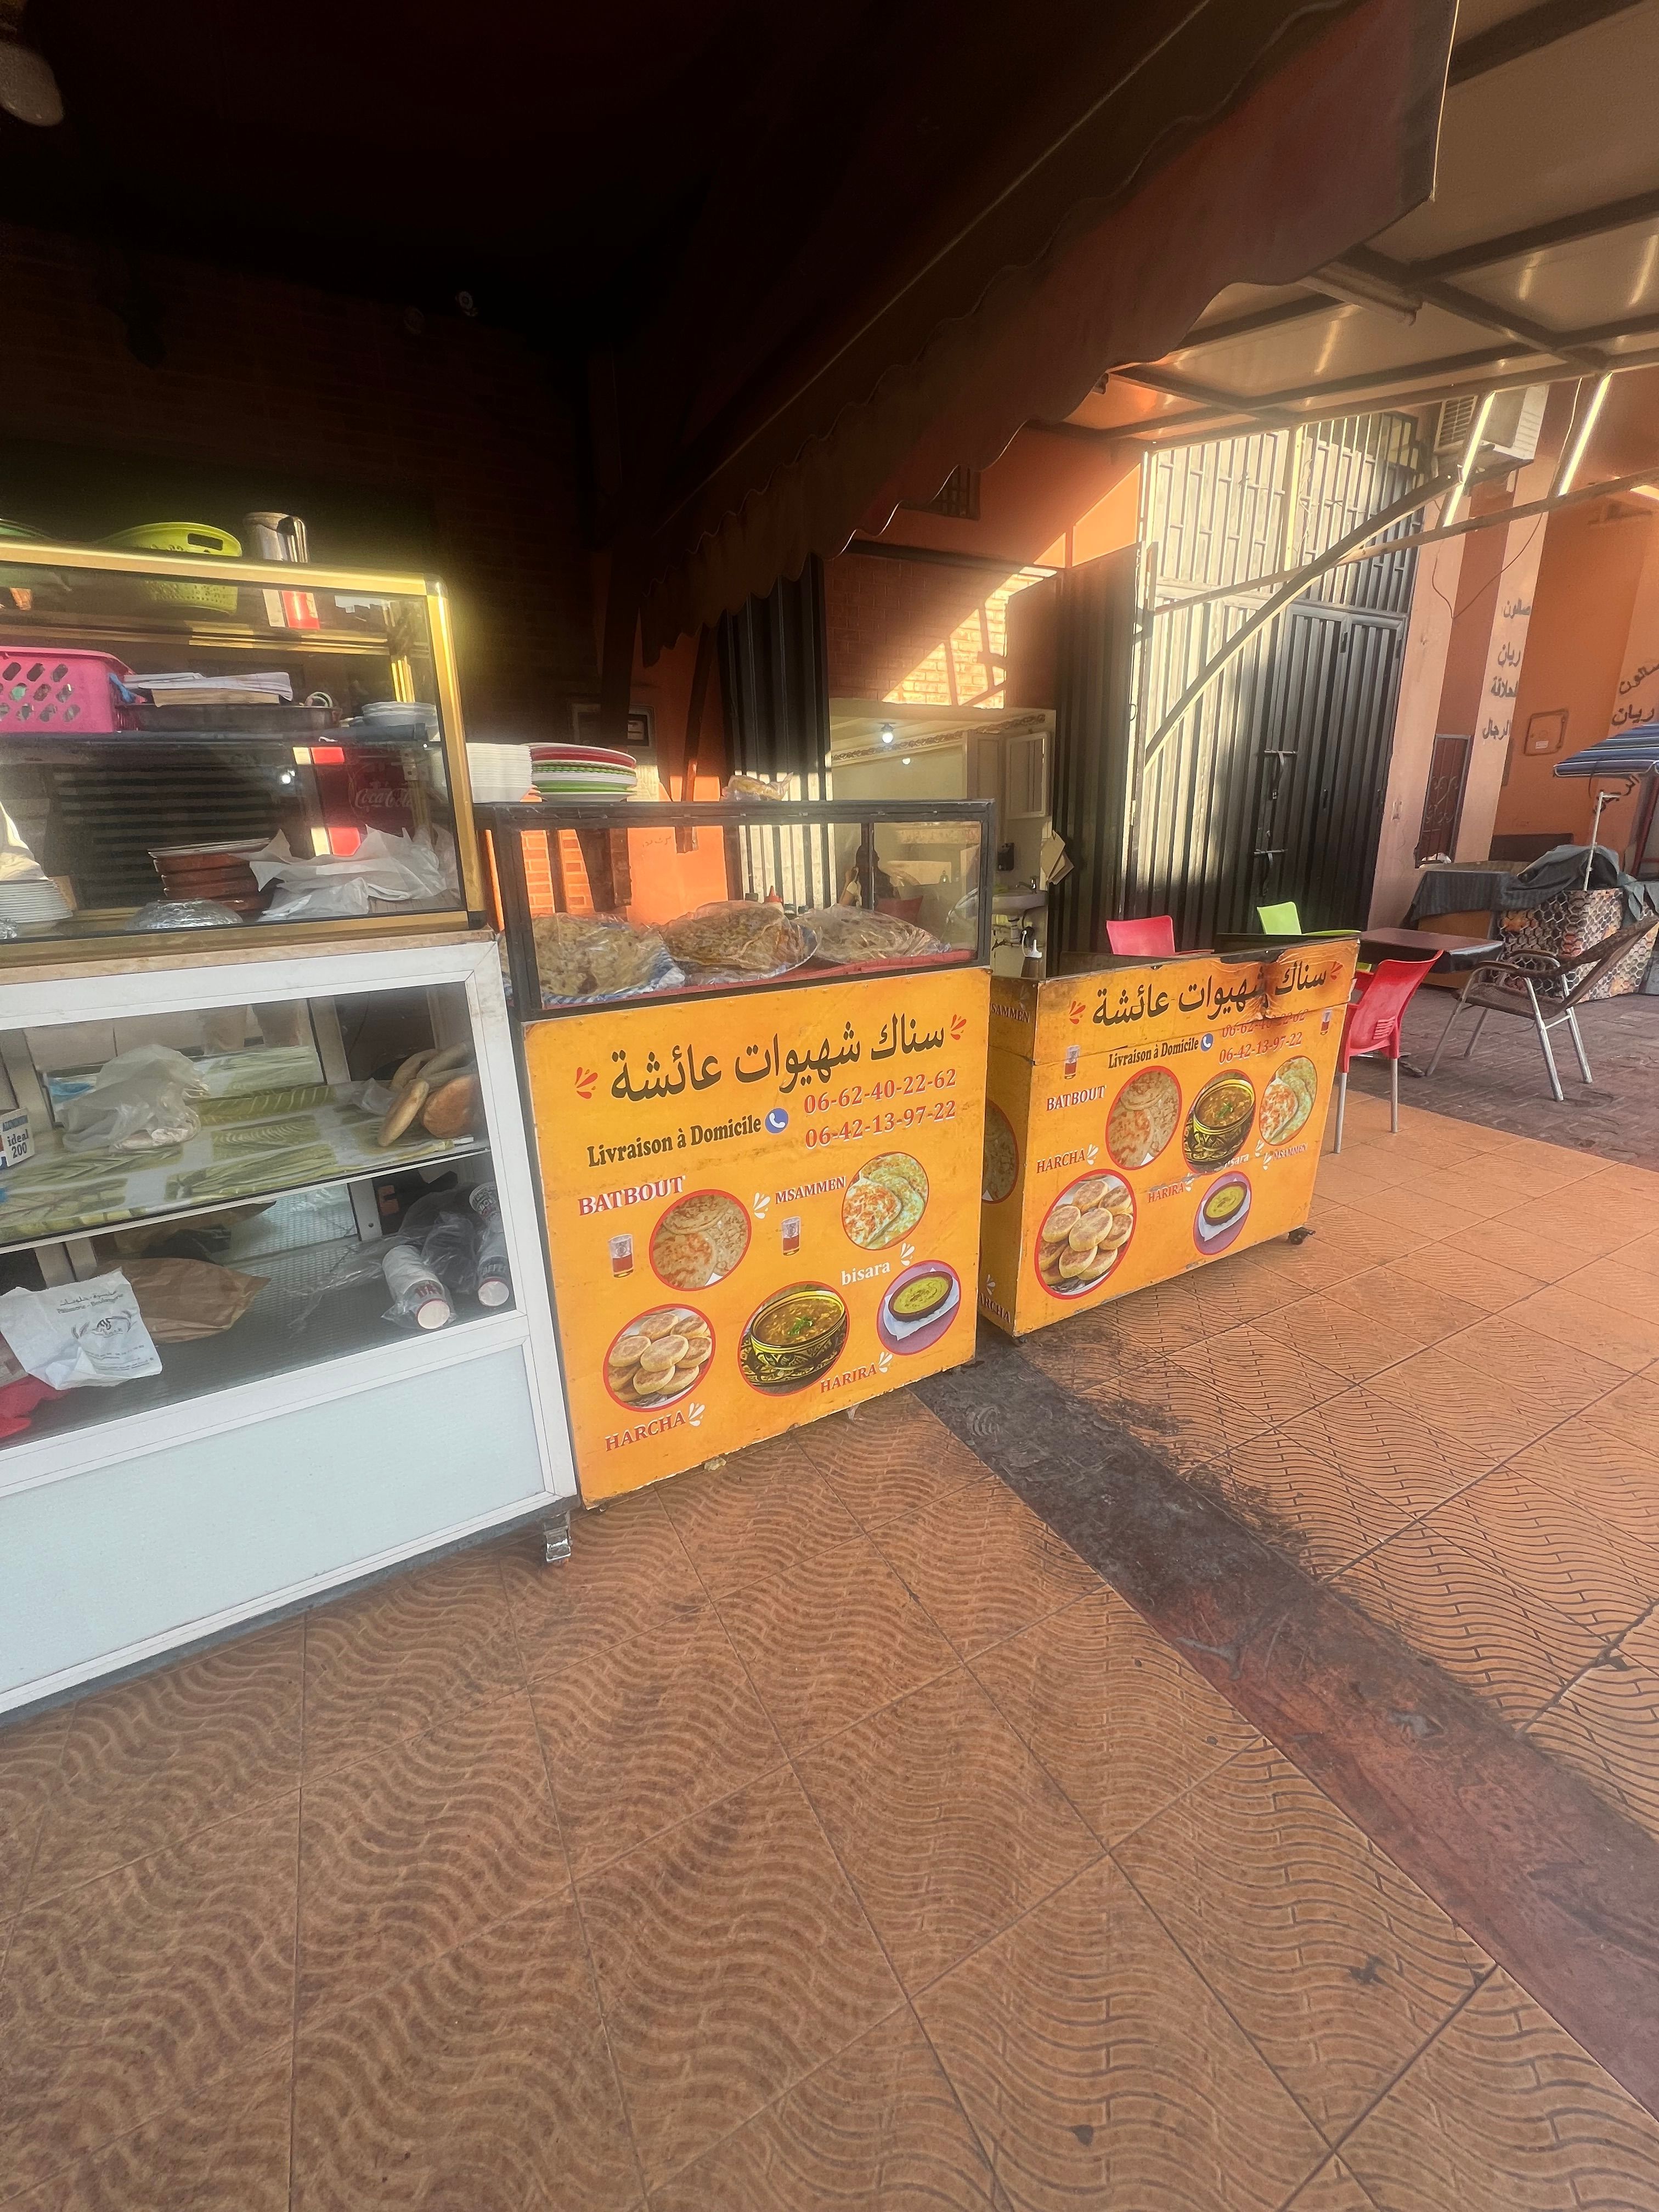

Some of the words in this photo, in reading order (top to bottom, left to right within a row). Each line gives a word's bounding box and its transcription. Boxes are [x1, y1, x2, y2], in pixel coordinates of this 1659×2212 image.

[1497, 641, 1521, 668] ريان
[1611, 704, 1655, 725] ريان
[1274, 960, 1327, 996] سناك
[990, 1002, 1030, 1023] SAMMEN
[1092, 983, 1169, 1026] عائشة
[871, 1012, 945, 1061] سناك
[1108, 1051, 1152, 1069] Livraison
[1153, 1047, 1159, 1059] à
[1160, 1036, 1199, 1057] Domicile
[1219, 1032, 1302, 1065] 06-42-13-97-22
[612, 1044, 722, 1102] عائشة
[735, 1021, 861, 1094] شهيوات
[804, 1069, 957, 1115] 06-62-40-22-62
[1046, 1085, 1107, 1111] BATBOUT
[7, 1128, 29, 1147] ideal
[587, 1135, 673, 1167] Livraison
[677, 1128, 686, 1148] à
[690, 1115, 761, 1146] Domicile
[805, 1100, 956, 1150] 06-42-13-97-22
[12, 1142, 27, 1159] 200
[1036, 1148, 1085, 1174] HARCHA
[577, 1176, 686, 1216] BATBOUT
[775, 1175, 847, 1205] MSAMMEN
[1148, 1181, 1184, 1204] HARIRA
[841, 1261, 890, 1286] bisara
[978, 1292, 1011, 1324] ARCHA
[820, 1363, 877, 1393] HARIRA
[605, 1410, 686, 1452] HARCHA
